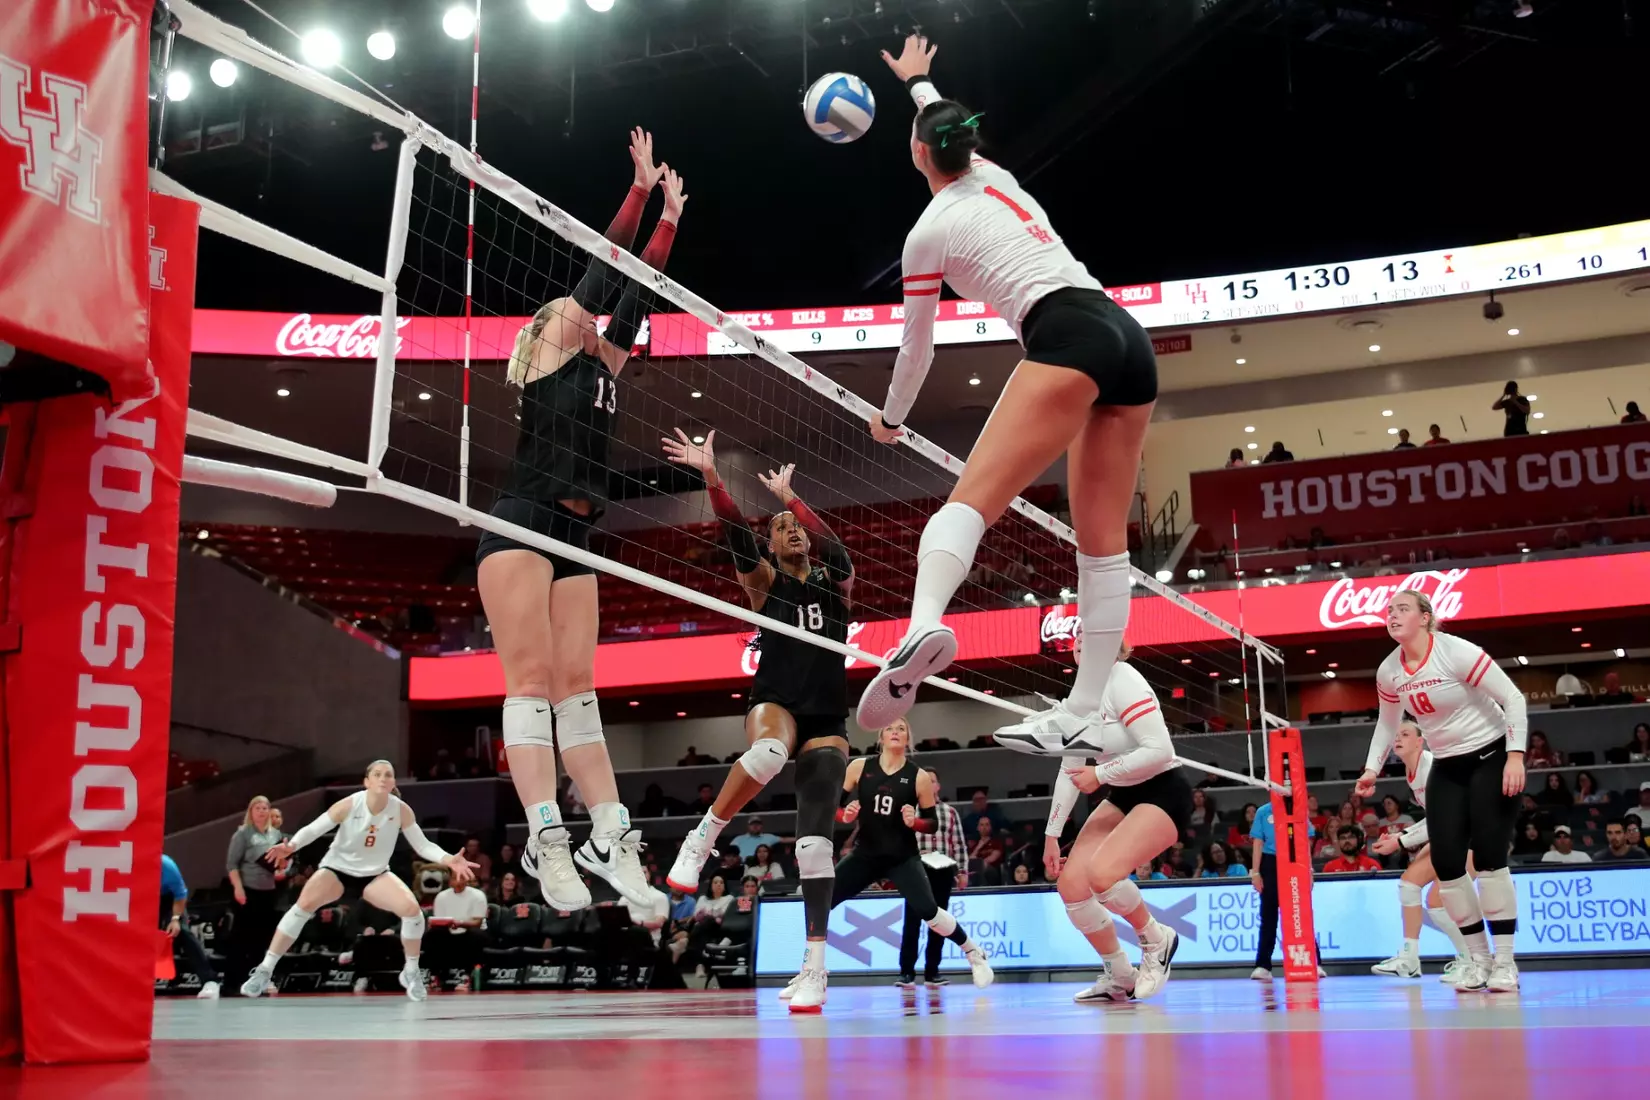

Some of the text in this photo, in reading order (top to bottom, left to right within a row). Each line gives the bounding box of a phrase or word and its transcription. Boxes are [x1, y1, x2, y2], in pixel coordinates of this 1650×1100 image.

[984, 186, 1033, 222] 1
[1382, 260, 1418, 282] 13
[1498, 263, 1543, 282] .261
[1577, 255, 1603, 271] 10
[1284, 266, 1350, 291] 1:30
[1223, 280, 1258, 300] 15
[791, 310, 826, 324] KILLS
[842, 308, 875, 322] ACES
[956, 301, 985, 315] DIGS
[1202, 310, 1211, 321] 2
[276, 313, 411, 358] Coca-Co
[811, 331, 822, 344] 9
[856, 329, 867, 342] 0
[976, 321, 987, 335] 8
[1260, 441, 1650, 519] HOUSTON COUG
[1319, 568, 1469, 629] Coca-Cla
[797, 602, 823, 630] 18
[1409, 691, 1436, 715] 18
[873, 794, 894, 815] 19
[1529, 876, 1592, 898] LOVB
[1530, 898, 1647, 920] HOUSTON
[1209, 912, 1262, 931] HOUS
[1530, 921, 1650, 943] VOLLEYBA
